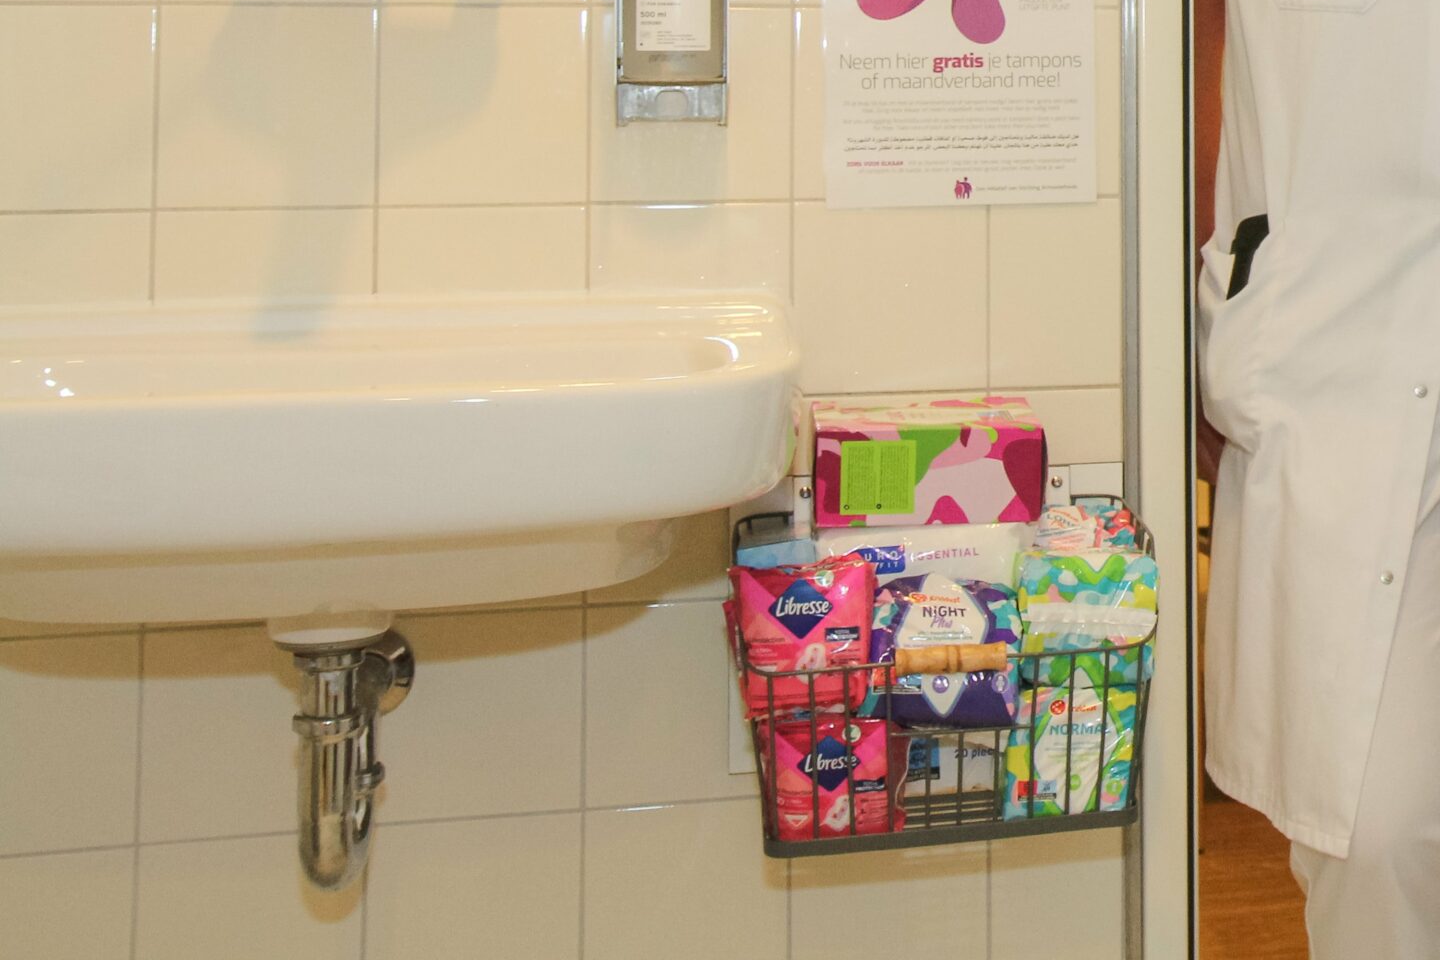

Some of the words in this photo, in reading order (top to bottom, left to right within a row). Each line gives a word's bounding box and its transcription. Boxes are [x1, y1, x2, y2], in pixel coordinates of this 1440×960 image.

[640, 10, 656, 18] 500
[839, 53, 892, 70] Neem
[896, 52, 929, 69] hier
[932, 52, 984, 73] gratis
[988, 52, 1002, 72] je
[1006, 53, 1083, 72] tampons
[861, 72, 879, 90] of
[883, 71, 1014, 89] maandverband
[1018, 71, 1061, 88] mee!
[775, 596, 831, 617] Libresse
